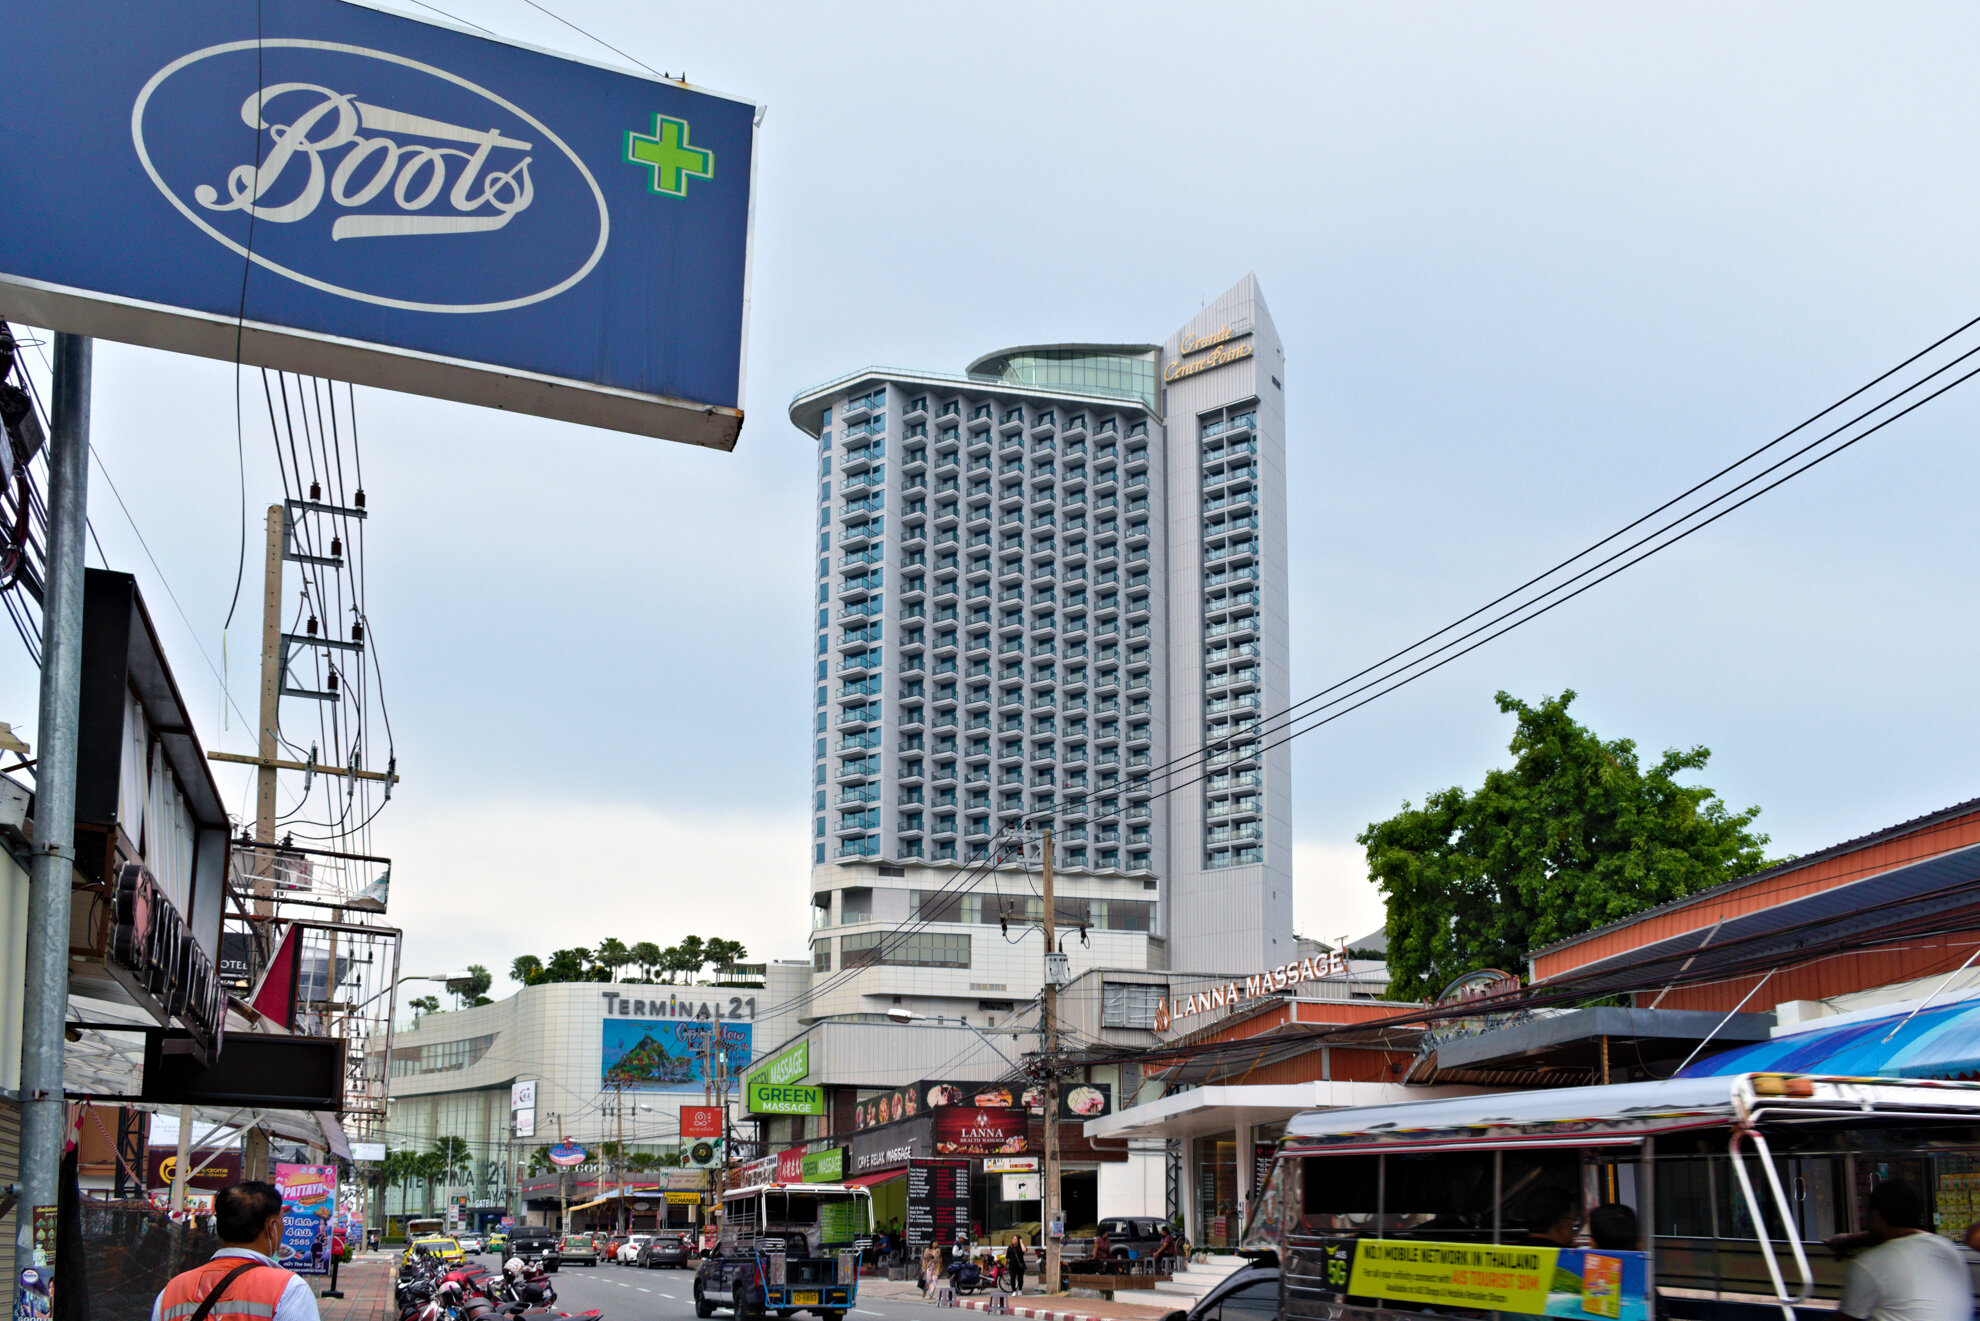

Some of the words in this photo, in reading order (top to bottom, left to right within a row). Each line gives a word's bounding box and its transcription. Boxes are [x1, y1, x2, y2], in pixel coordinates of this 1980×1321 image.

[195, 82, 532, 241] Boots
[1181, 325, 1232, 354] Grande
[1164, 360, 1206, 381] Centre
[1207, 343, 1252, 367] Point
[220, 959, 248, 970] OTEL
[1173, 982, 1241, 1019] LANNA
[1246, 946, 1346, 999] MASSAGE
[771, 1048, 803, 1085] MASSAGE
[758, 1087, 816, 1103] GREEN
[762, 1102, 812, 1113] MASSAGE
[961, 1128, 1004, 1138] LANNA
[886, 1145, 912, 1163] MASSAGE
[804, 1161, 818, 1177] GREEN
[818, 1155, 842, 1175] MASSAGE
[284, 1182, 324, 1199] PATTAYA
[282, 1217, 294, 1226] 31
[286, 1228, 294, 1237] 4
[289, 1238, 310, 1246] 2565
[1334, 1251, 1347, 1259] AIS
[1384, 1246, 1419, 1262] MOBILE
[1422, 1248, 1467, 1265] NETWORK
[1473, 1251, 1481, 1266] IN
[1485, 1252, 1539, 1270] THAILAND
[1328, 1260, 1347, 1285] 5G
[1452, 1269, 1468, 1285] AIS
[1470, 1271, 1515, 1289] TOURIST
[1517, 1274, 1540, 1291] SIM
